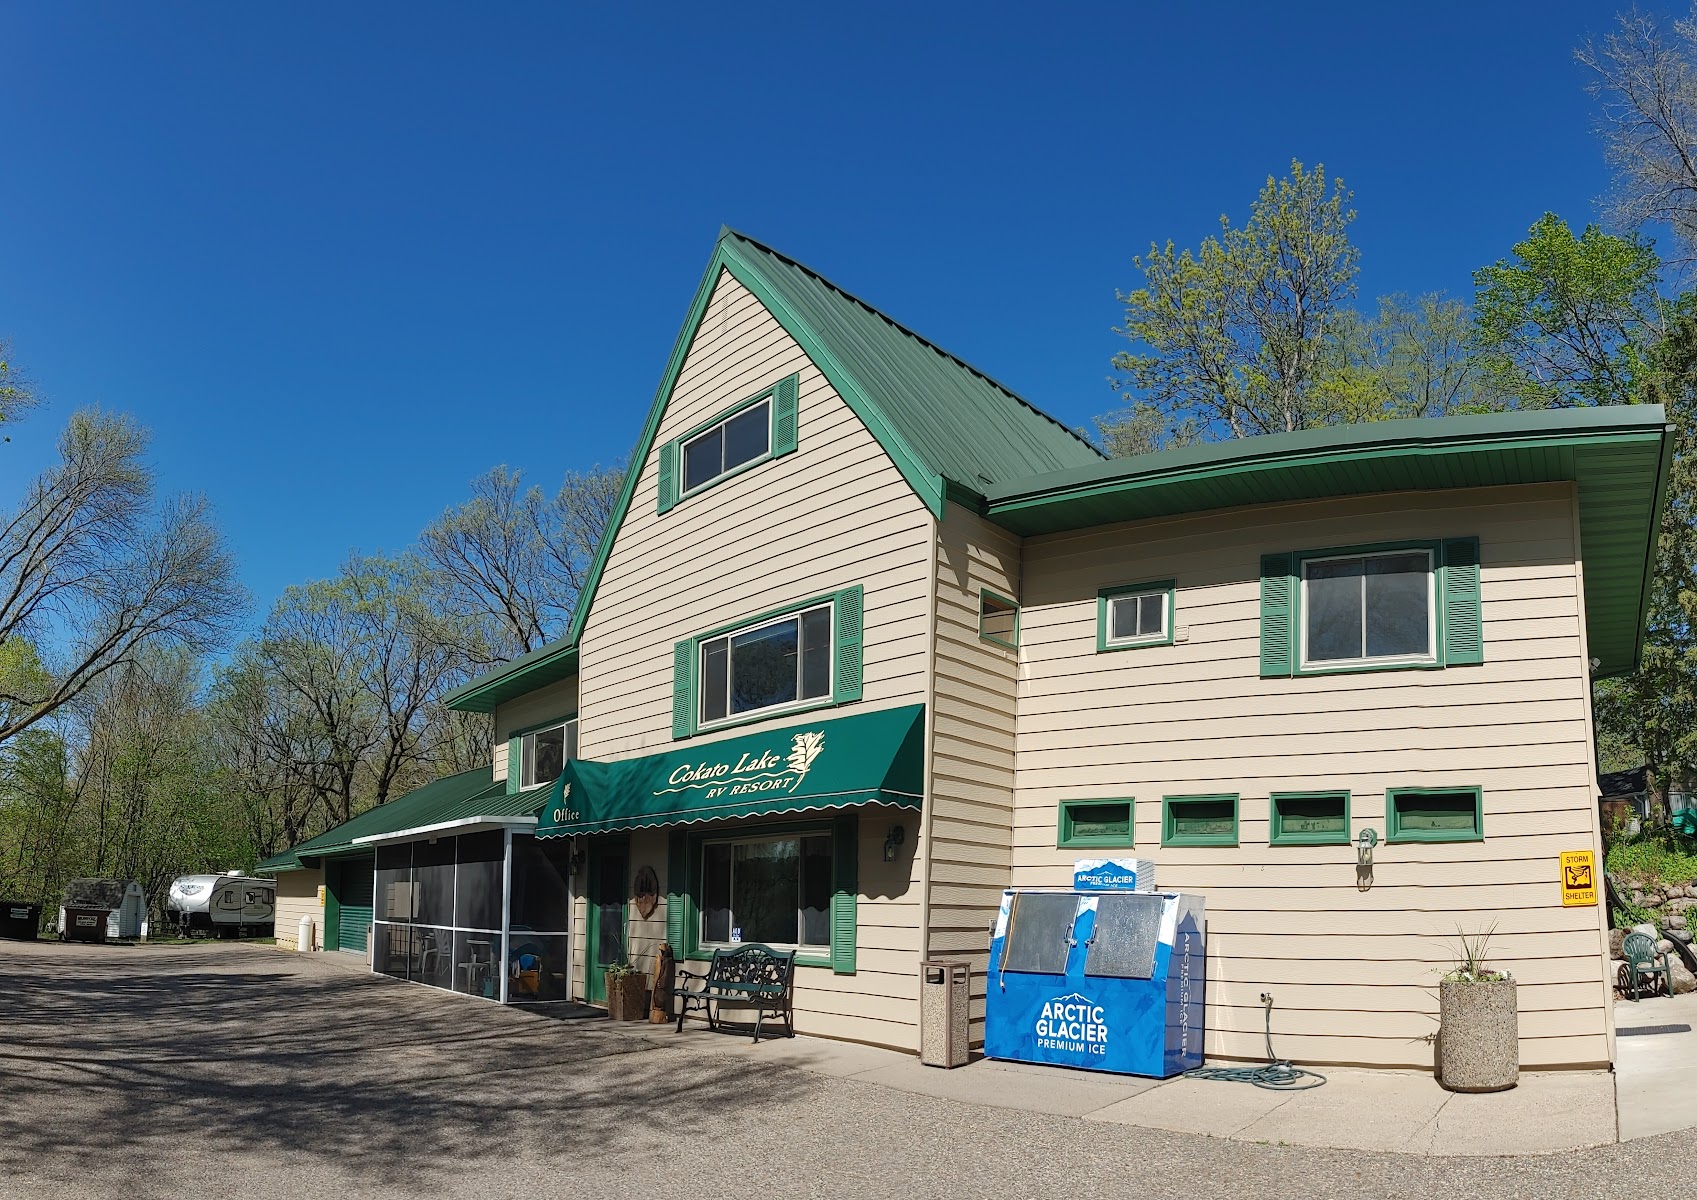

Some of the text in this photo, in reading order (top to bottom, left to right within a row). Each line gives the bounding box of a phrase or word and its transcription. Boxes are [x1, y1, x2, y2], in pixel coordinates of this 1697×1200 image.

[668, 749, 780, 785] Cokato Lake
[705, 777, 794, 799] RV RESORT
[553, 808, 580, 823] Office
[1077, 874, 1133, 884] ARCTIC GLACIER
[1565, 892, 1593, 900] SHELTER
[1041, 1002, 1105, 1024] ARCTIC
[1181, 991, 1189, 1057] GLACIER
[1036, 1019, 1108, 1043] GLACIER
[1037, 1038, 1106, 1055] PREMIUM ICE
